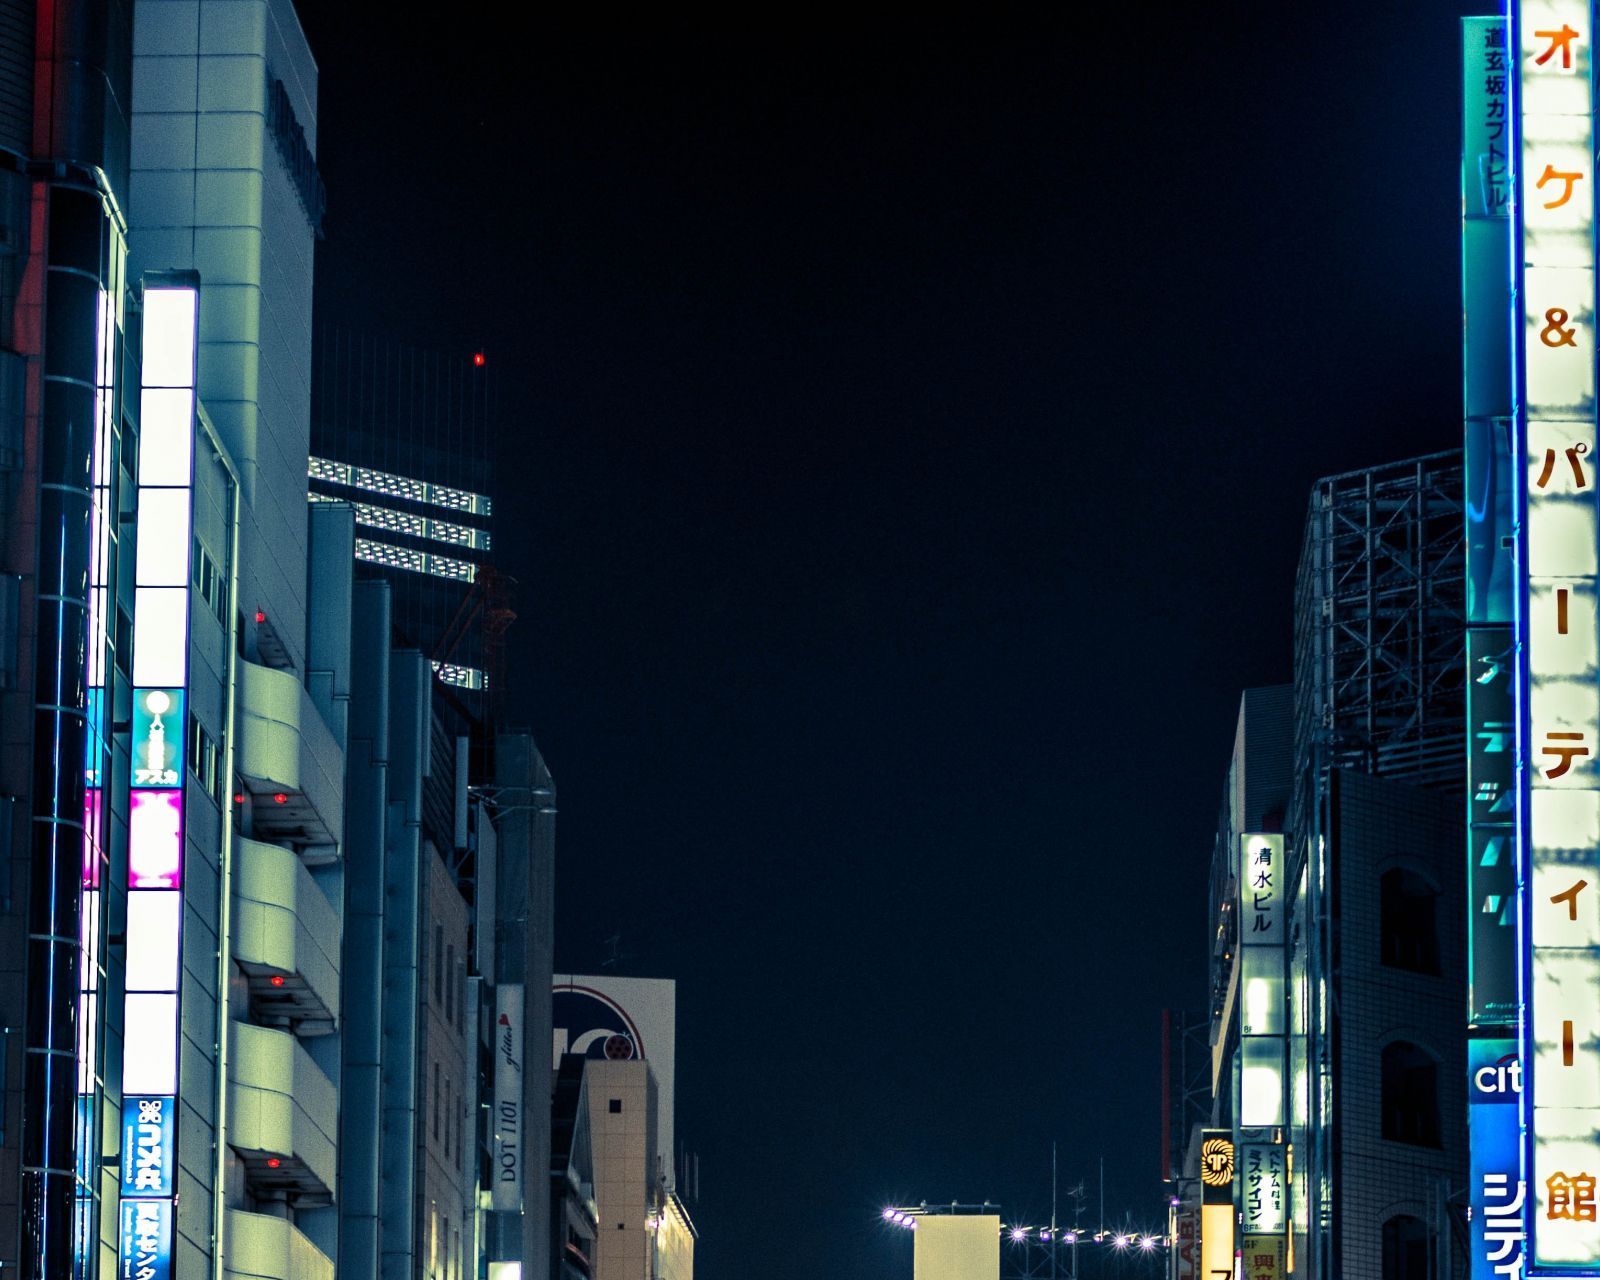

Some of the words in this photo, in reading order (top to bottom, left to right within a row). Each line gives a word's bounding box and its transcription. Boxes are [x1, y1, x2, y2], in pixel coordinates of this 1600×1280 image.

[1252, 847, 1273, 932] 清水ビル
[502, 1100, 518, 1134] 1101
[501, 1137, 517, 1183] DOT
